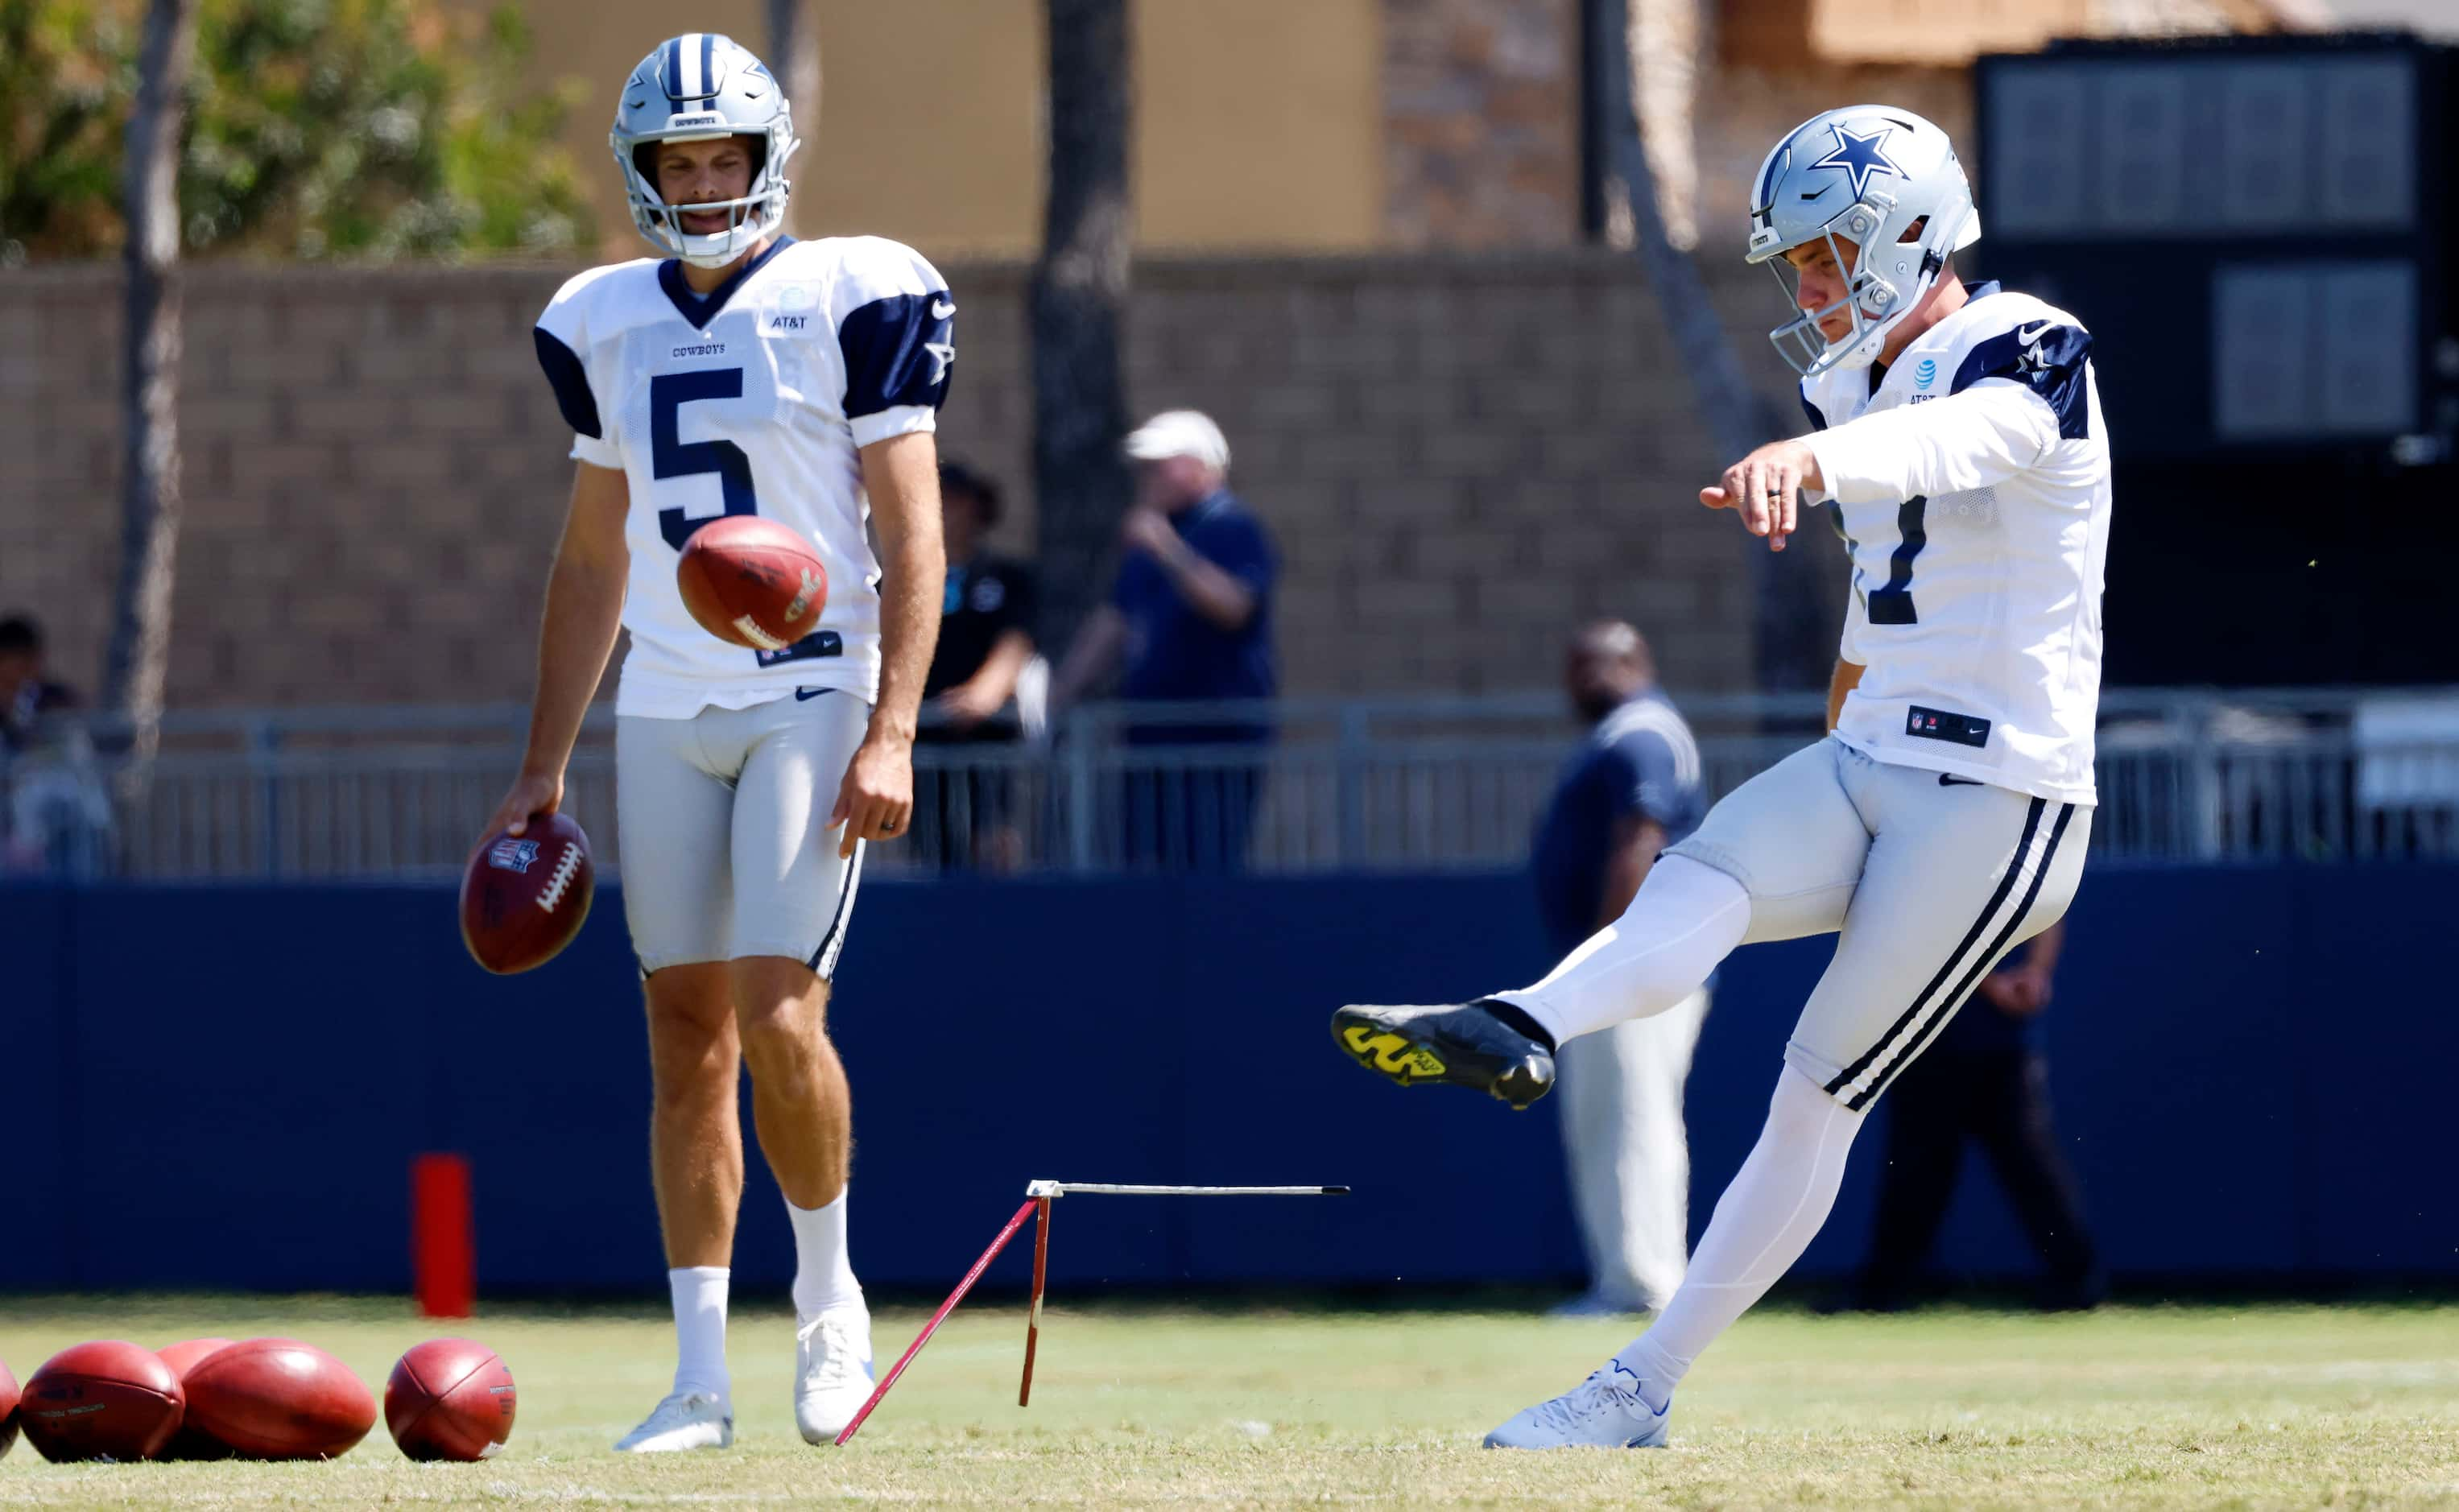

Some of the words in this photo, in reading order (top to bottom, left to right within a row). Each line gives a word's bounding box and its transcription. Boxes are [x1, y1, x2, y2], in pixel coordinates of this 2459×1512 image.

[772, 316, 807, 328] AT&T
[673, 344, 725, 357] COWBOYS
[651, 367, 758, 552] 5
